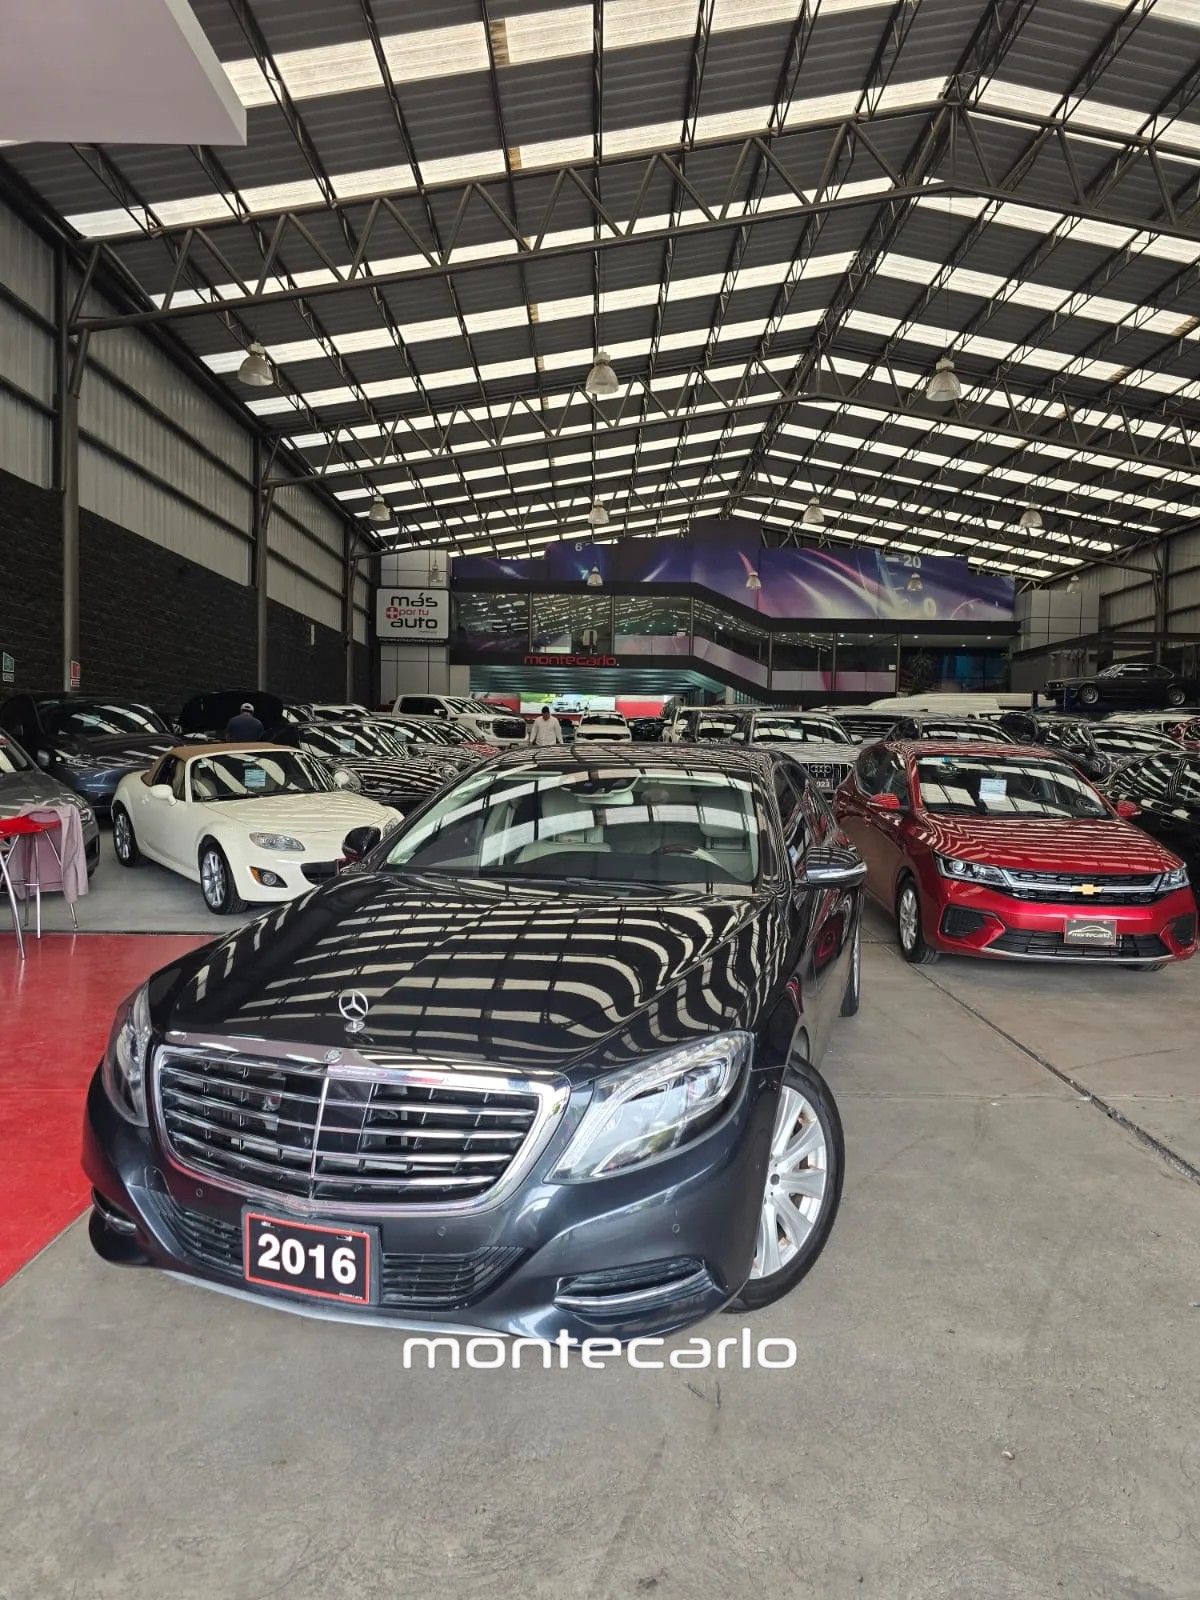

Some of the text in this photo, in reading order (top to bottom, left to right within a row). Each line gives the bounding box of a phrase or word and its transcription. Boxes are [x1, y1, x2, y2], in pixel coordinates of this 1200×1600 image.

[903, 555, 922, 569] 20
[391, 593, 438, 607] más
[399, 608, 429, 617] por tu
[391, 617, 438, 629] auto
[257, 1232, 357, 1285] 2016
